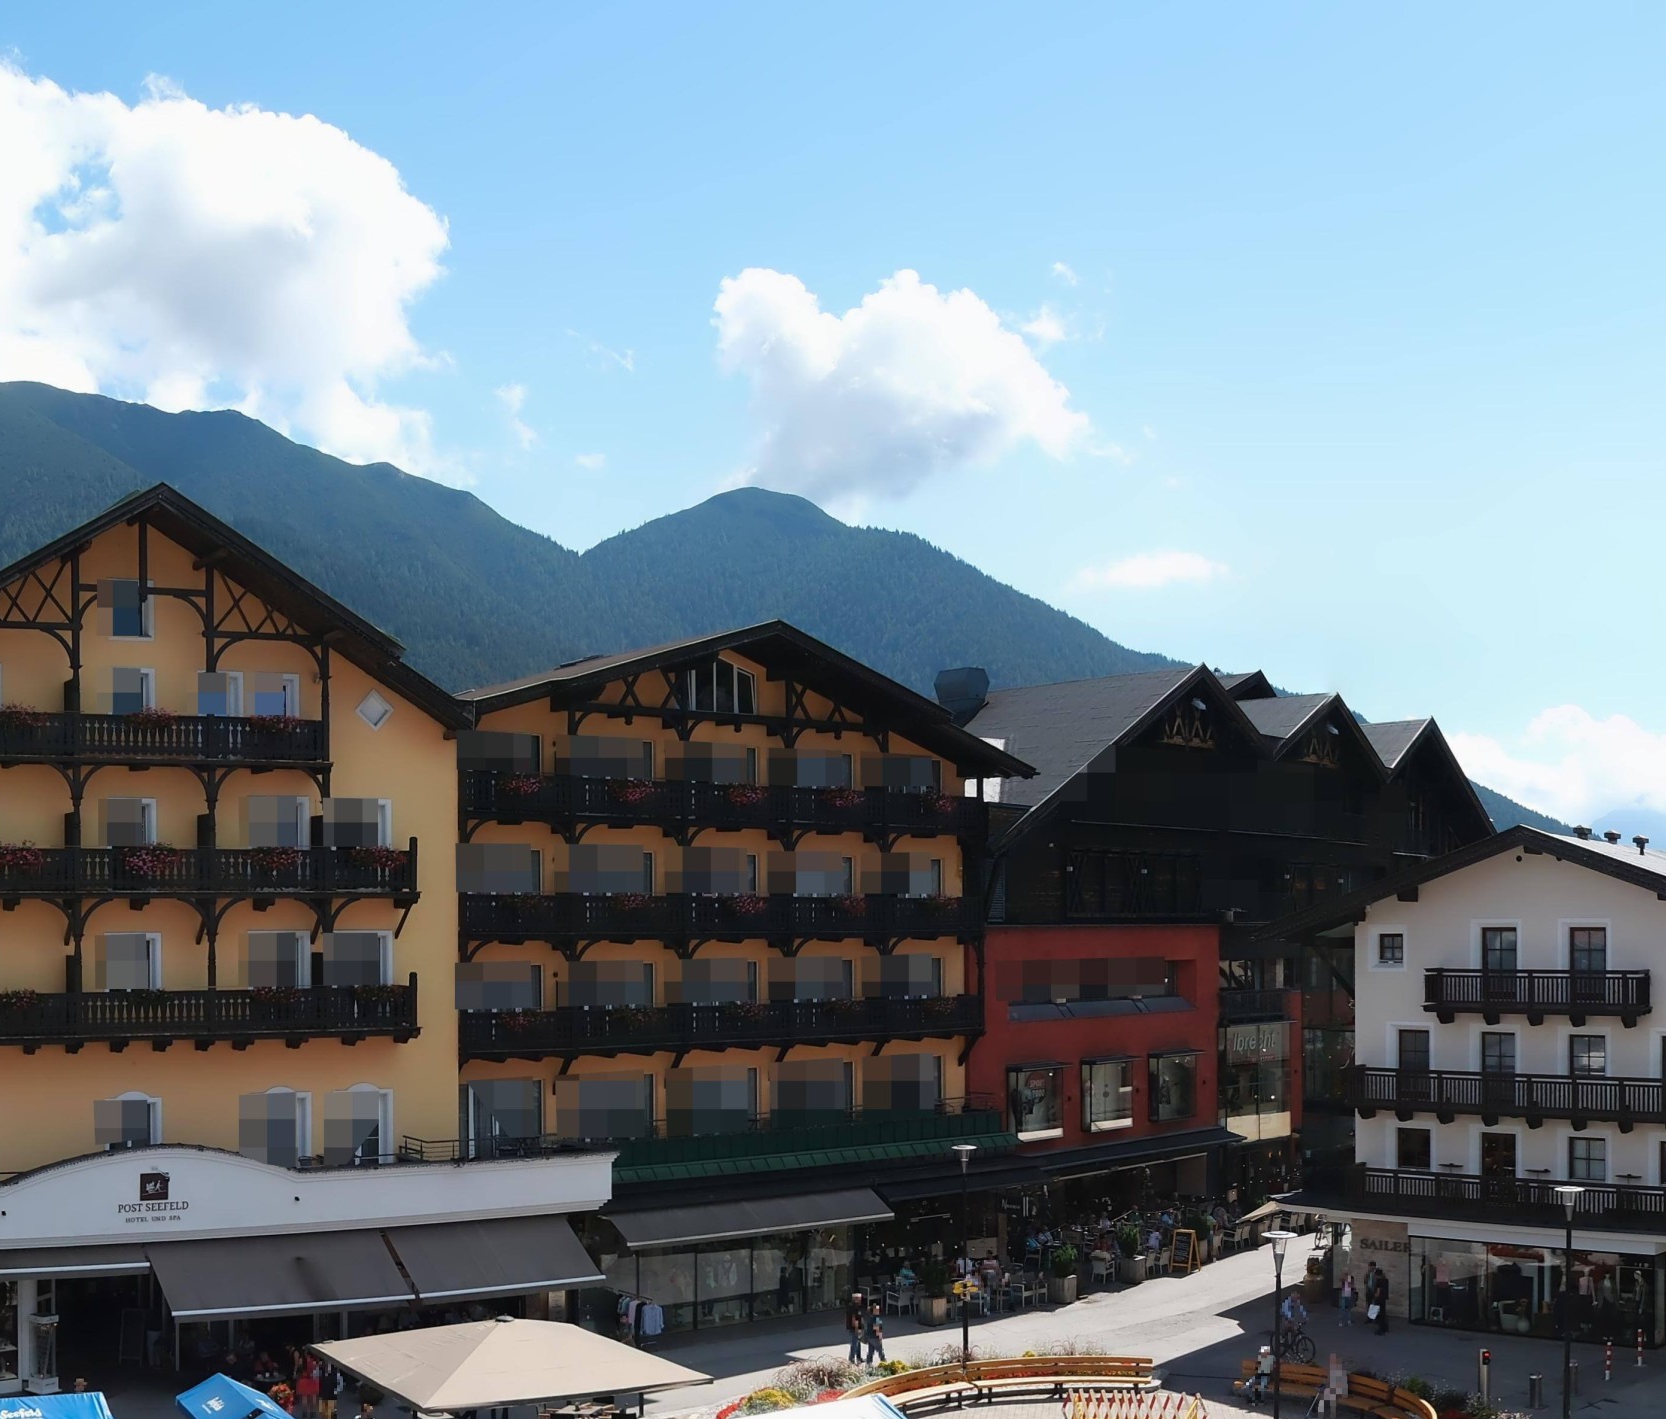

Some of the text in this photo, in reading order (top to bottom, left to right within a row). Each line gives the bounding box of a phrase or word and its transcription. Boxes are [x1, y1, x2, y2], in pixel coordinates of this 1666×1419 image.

[117, 1200, 190, 1214] POST SEEFELD
[125, 1216, 149, 1224] HOTEL
[151, 1215, 166, 1223] UND
[1359, 1238, 1412, 1254] SAILER
